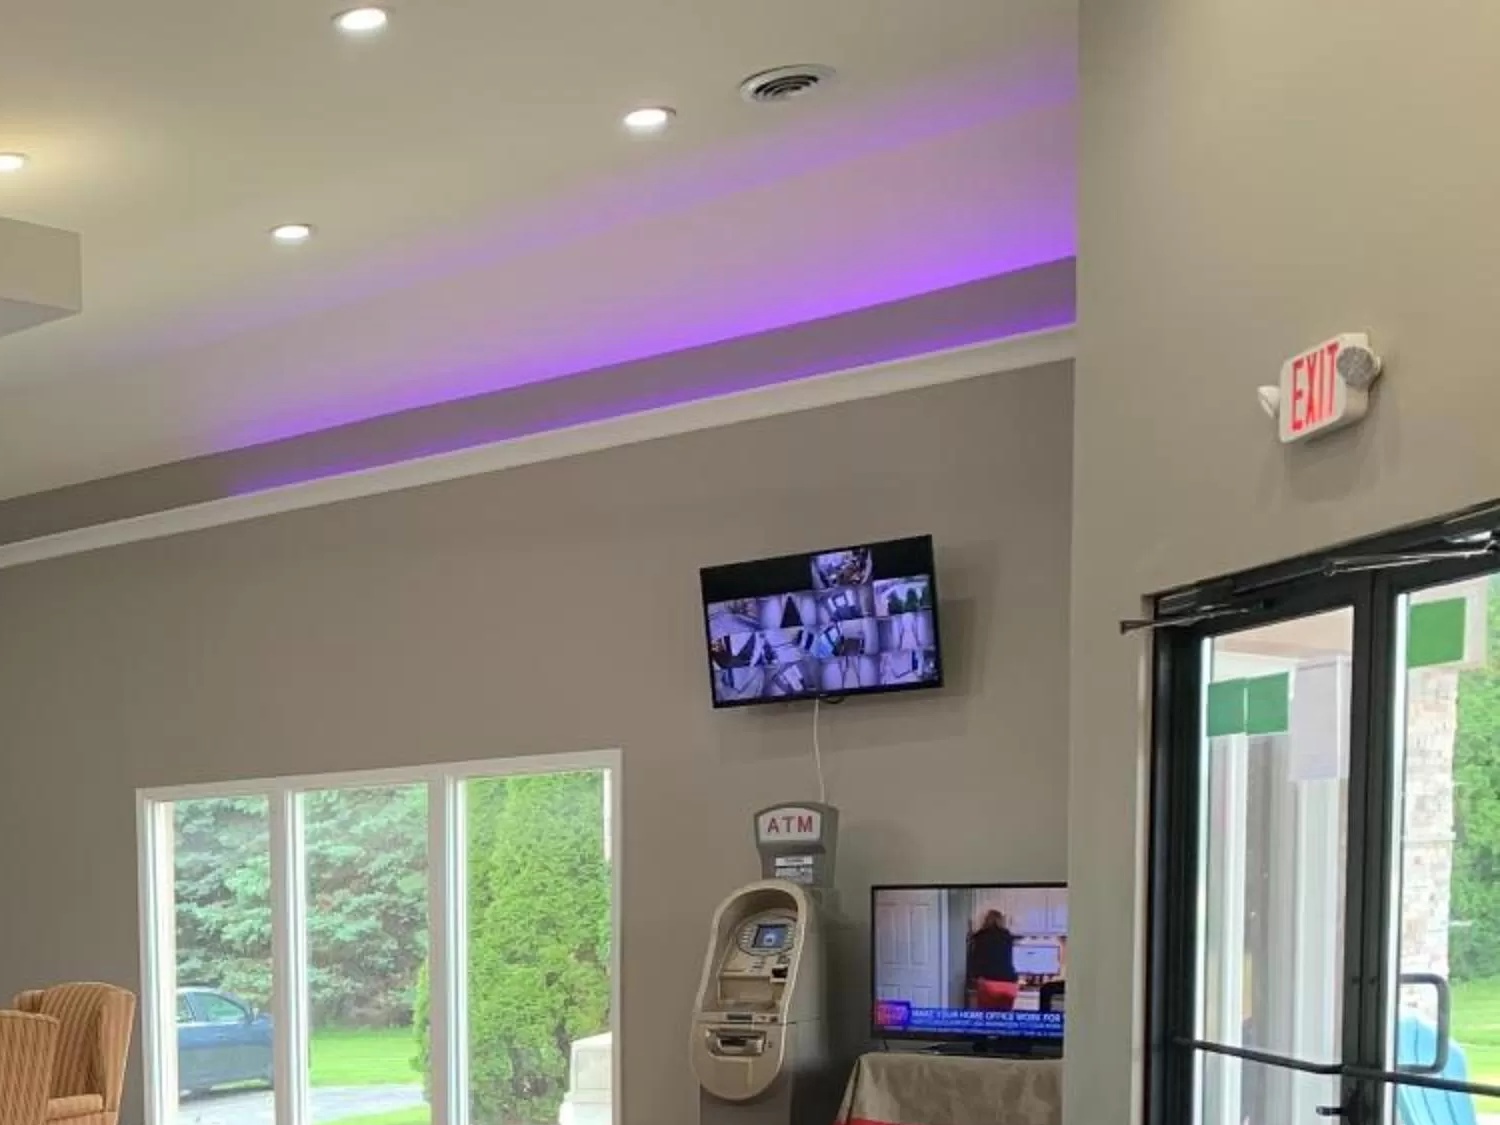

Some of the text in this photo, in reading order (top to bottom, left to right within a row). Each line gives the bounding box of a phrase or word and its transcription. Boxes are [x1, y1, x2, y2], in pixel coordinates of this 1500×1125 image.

[1292, 341, 1339, 432] EXIT
[767, 815, 813, 833] ATM
[960, 1011, 984, 1019] HOME
[1043, 1013, 1061, 1022] FOR
